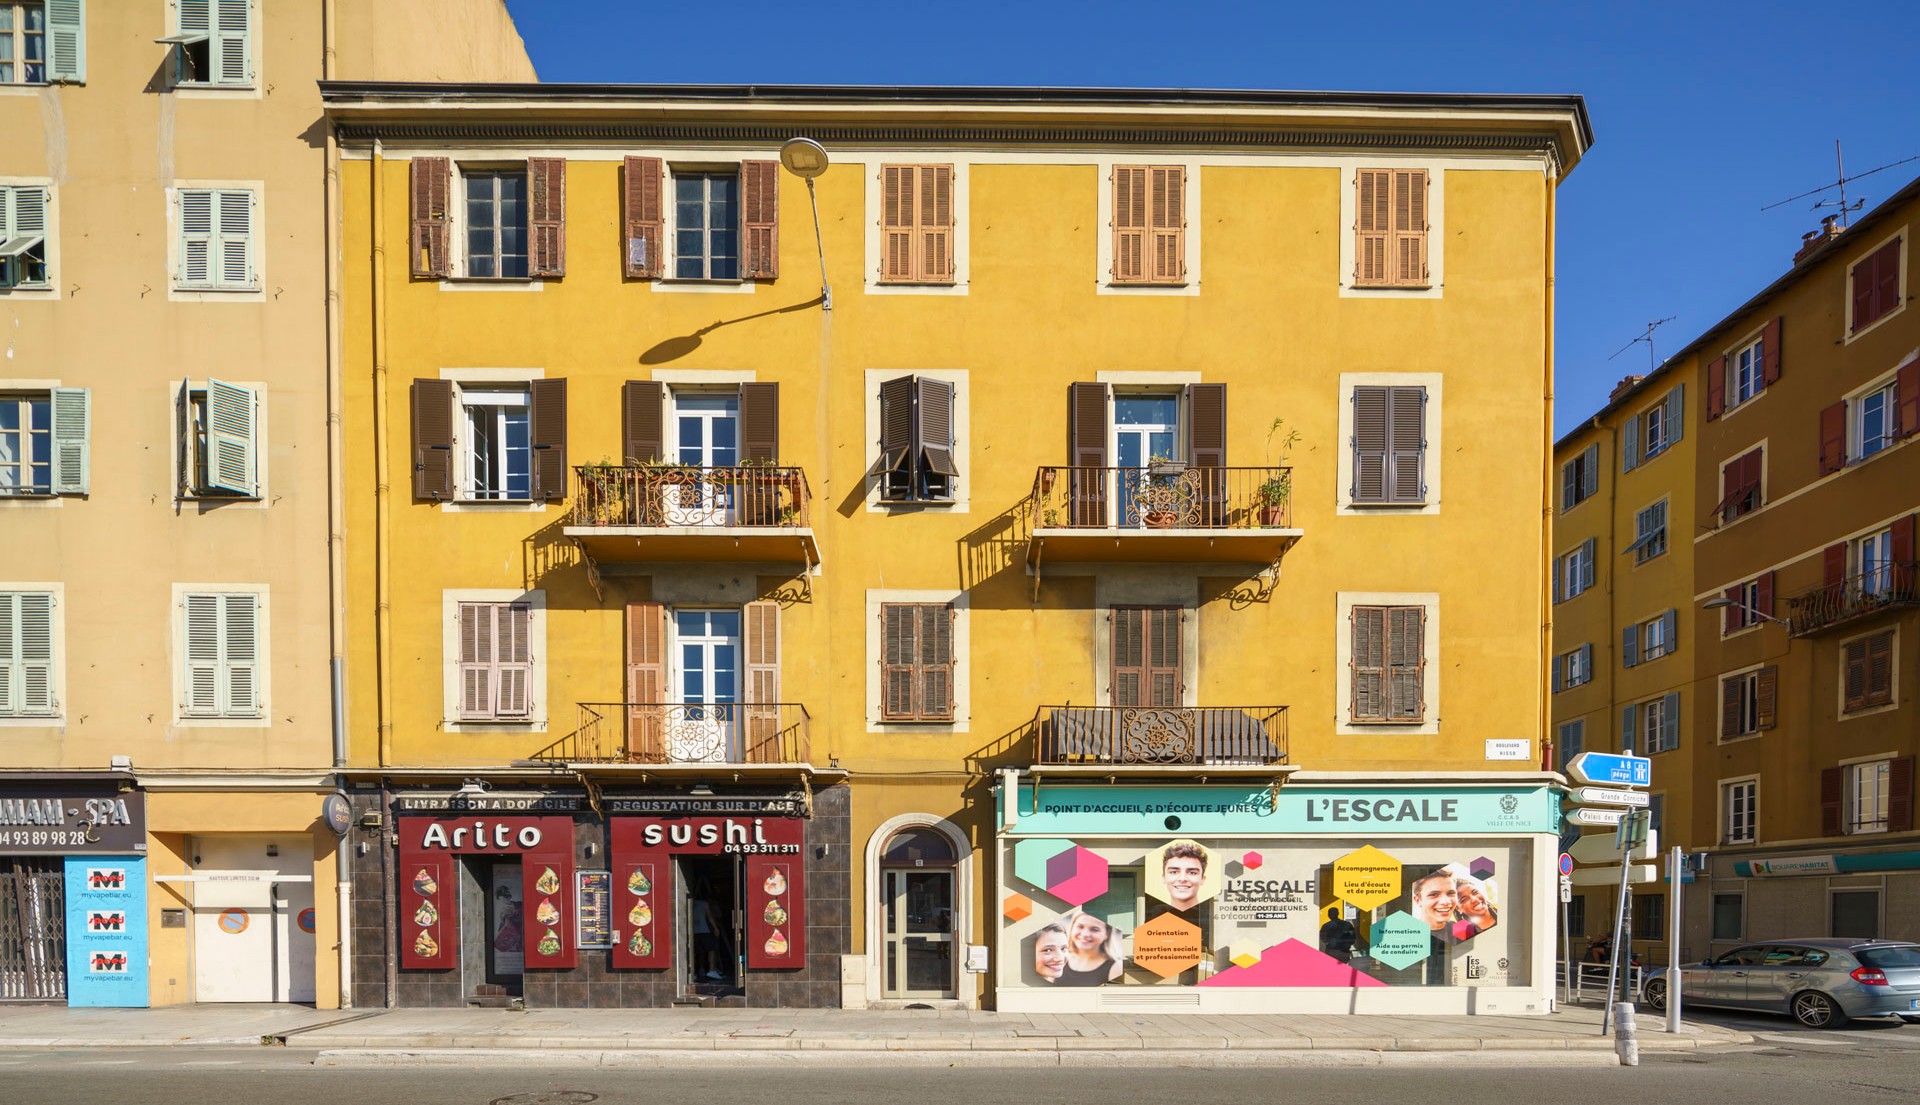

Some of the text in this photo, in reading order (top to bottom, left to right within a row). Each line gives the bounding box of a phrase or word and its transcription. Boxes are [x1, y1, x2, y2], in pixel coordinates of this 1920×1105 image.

[1612, 770, 1630, 780] péage
[1601, 792, 1646, 803] Grande Corniche
[404, 800, 488, 810] LIVRAISON
[491, 800, 501, 810] A
[613, 801, 795, 811] DEGUSTATION SUR PLACE
[1045, 801, 1258, 813] POINT D'ACCUEIL & D'ÉCOUTE JEUNES
[85, 799, 131, 825] SPA
[1306, 799, 1459, 822] L'ESCALE
[1583, 812, 1601, 821] Palais
[1604, 813, 1613, 821] des
[423, 821, 542, 848] Arito
[644, 819, 767, 845] sushi
[13, 831, 29, 846] 93
[32, 831, 48, 846] 89
[51, 831, 67, 846] 98
[69, 831, 85, 846] 28
[724, 844, 800, 854] 04 93 311 311
[1337, 865, 1398, 873] Accompagnement
[1227, 880, 1316, 893] L'ESCALE
[81, 891, 132, 899] myvapebar.eu
[1145, 953, 1200, 961] professionnelle
[83, 974, 133, 982] myvapebar.eu
